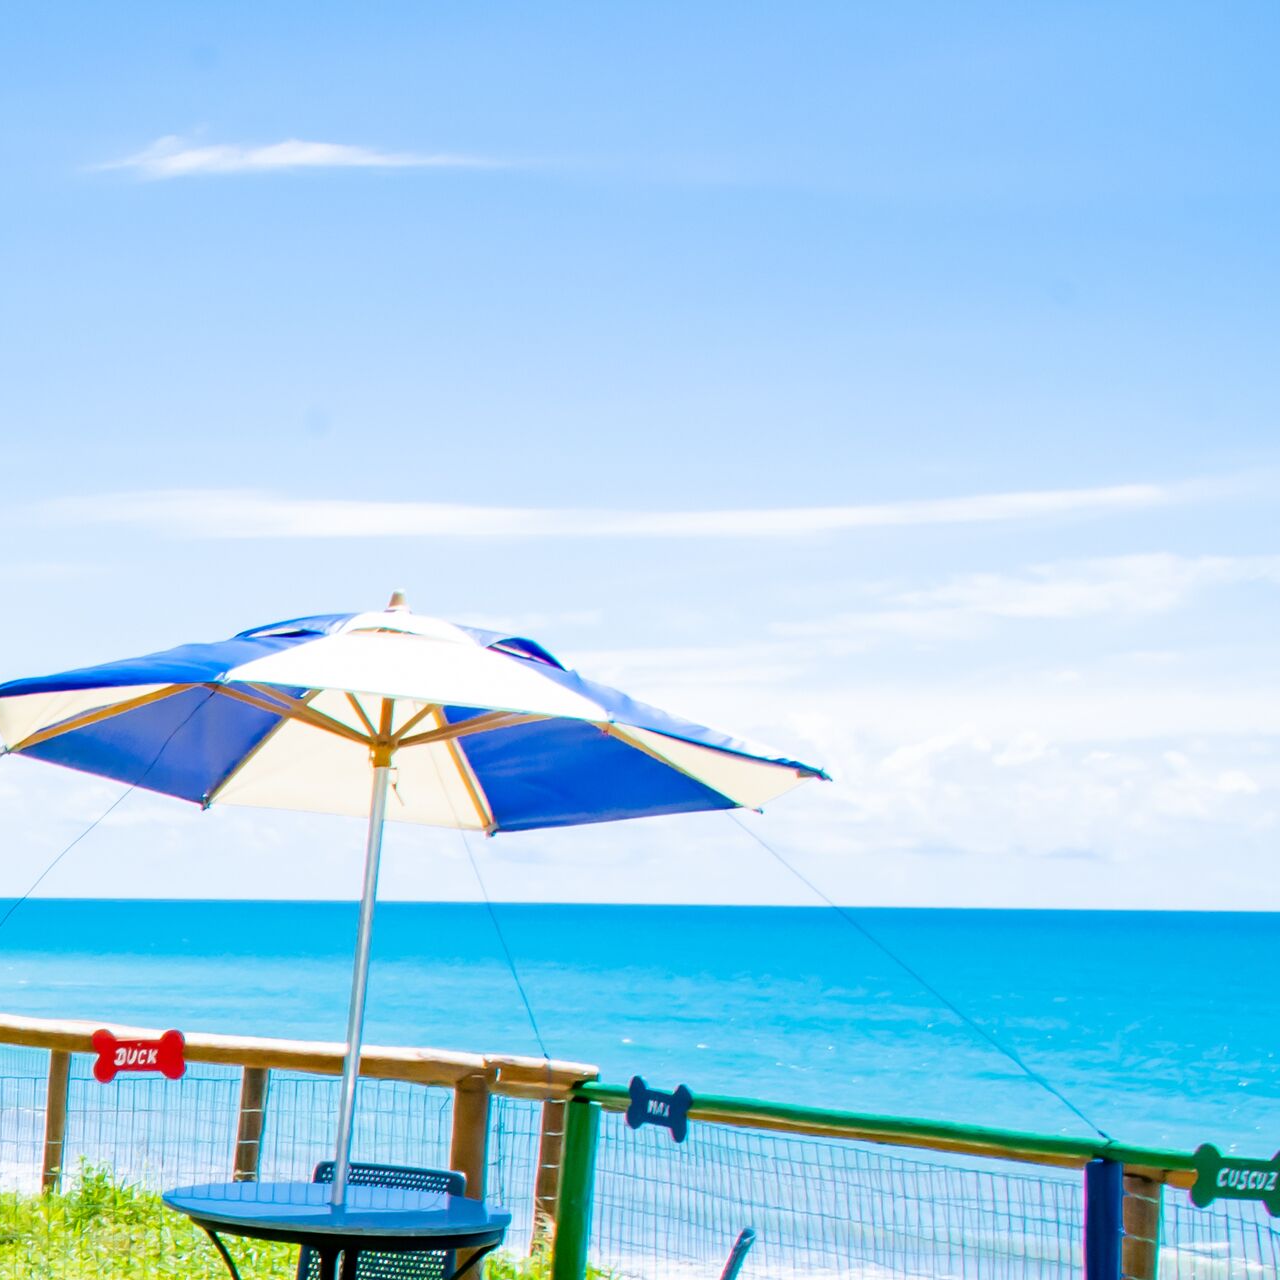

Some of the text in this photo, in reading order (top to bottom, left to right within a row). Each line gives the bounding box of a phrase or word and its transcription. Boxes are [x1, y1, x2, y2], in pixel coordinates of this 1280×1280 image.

[113, 1047, 158, 1066] DUCK
[647, 1099, 670, 1117] MAX
[1216, 1167, 1278, 1191] CUSCUZ
